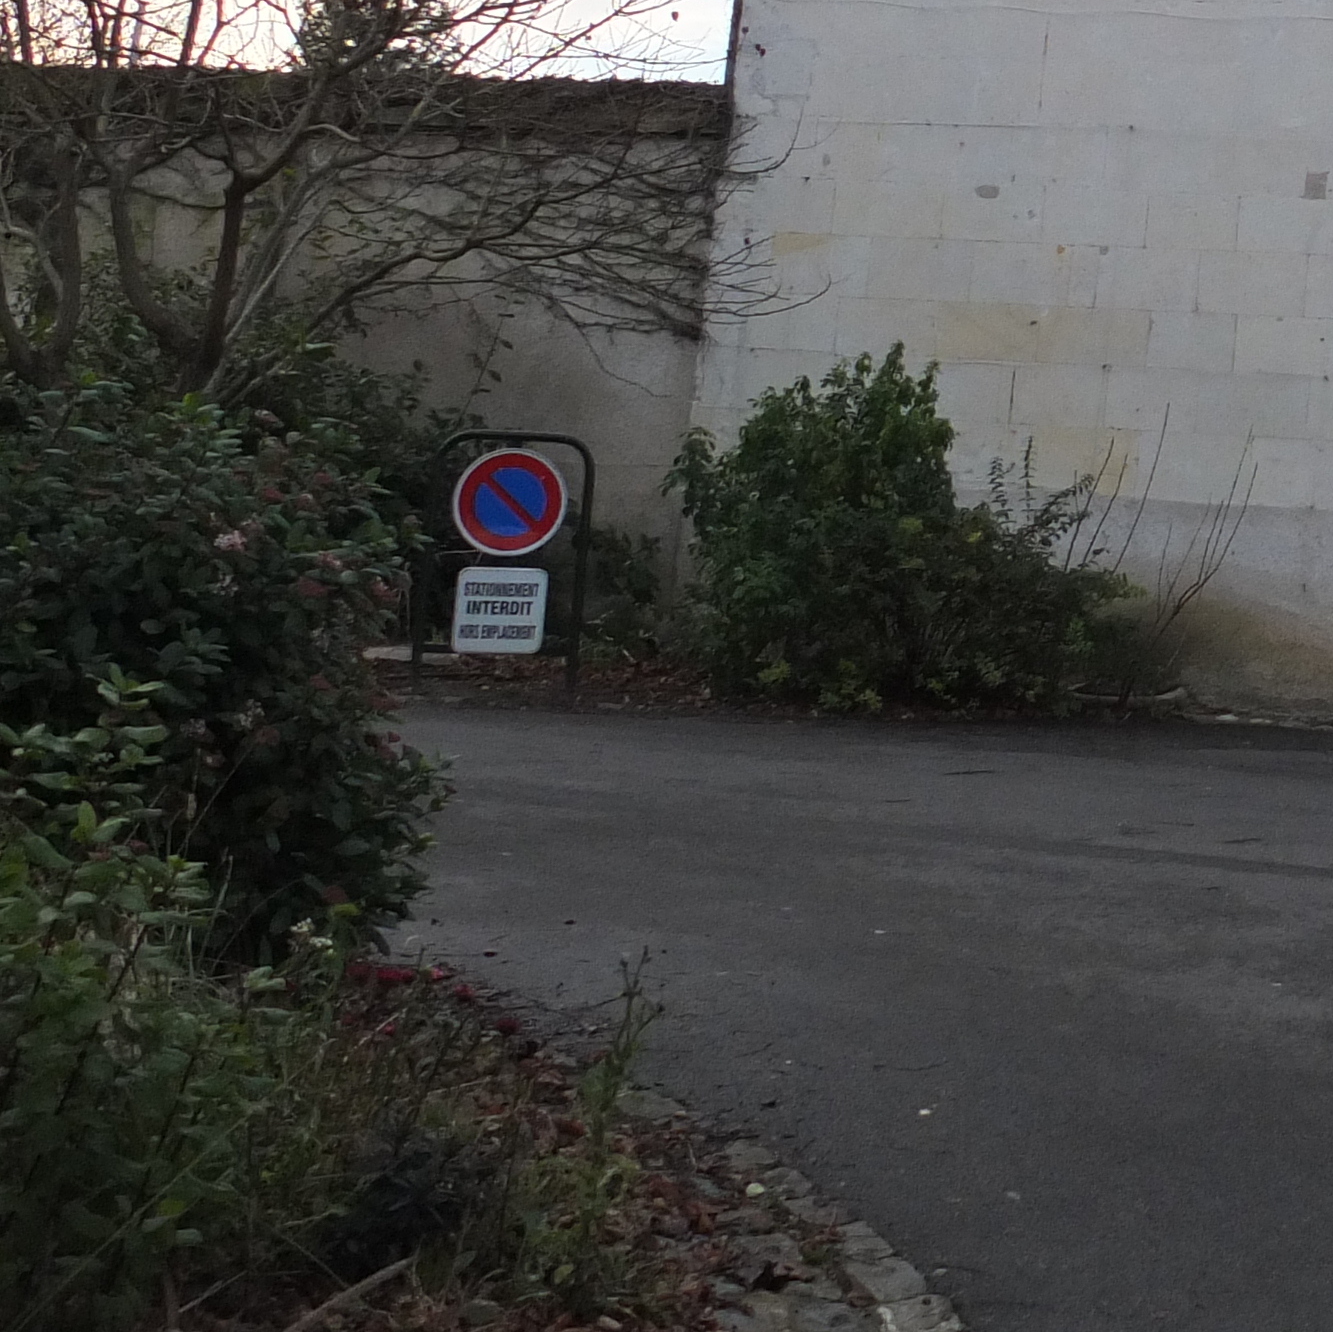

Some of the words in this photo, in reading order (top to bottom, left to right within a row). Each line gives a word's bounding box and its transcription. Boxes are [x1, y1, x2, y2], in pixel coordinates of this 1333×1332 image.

[464, 582, 539, 597] STATIONNEMENT
[466, 600, 534, 616] INTERDIT
[458, 625, 479, 640] HORS
[480, 625, 537, 640] EMPLACEMENT
